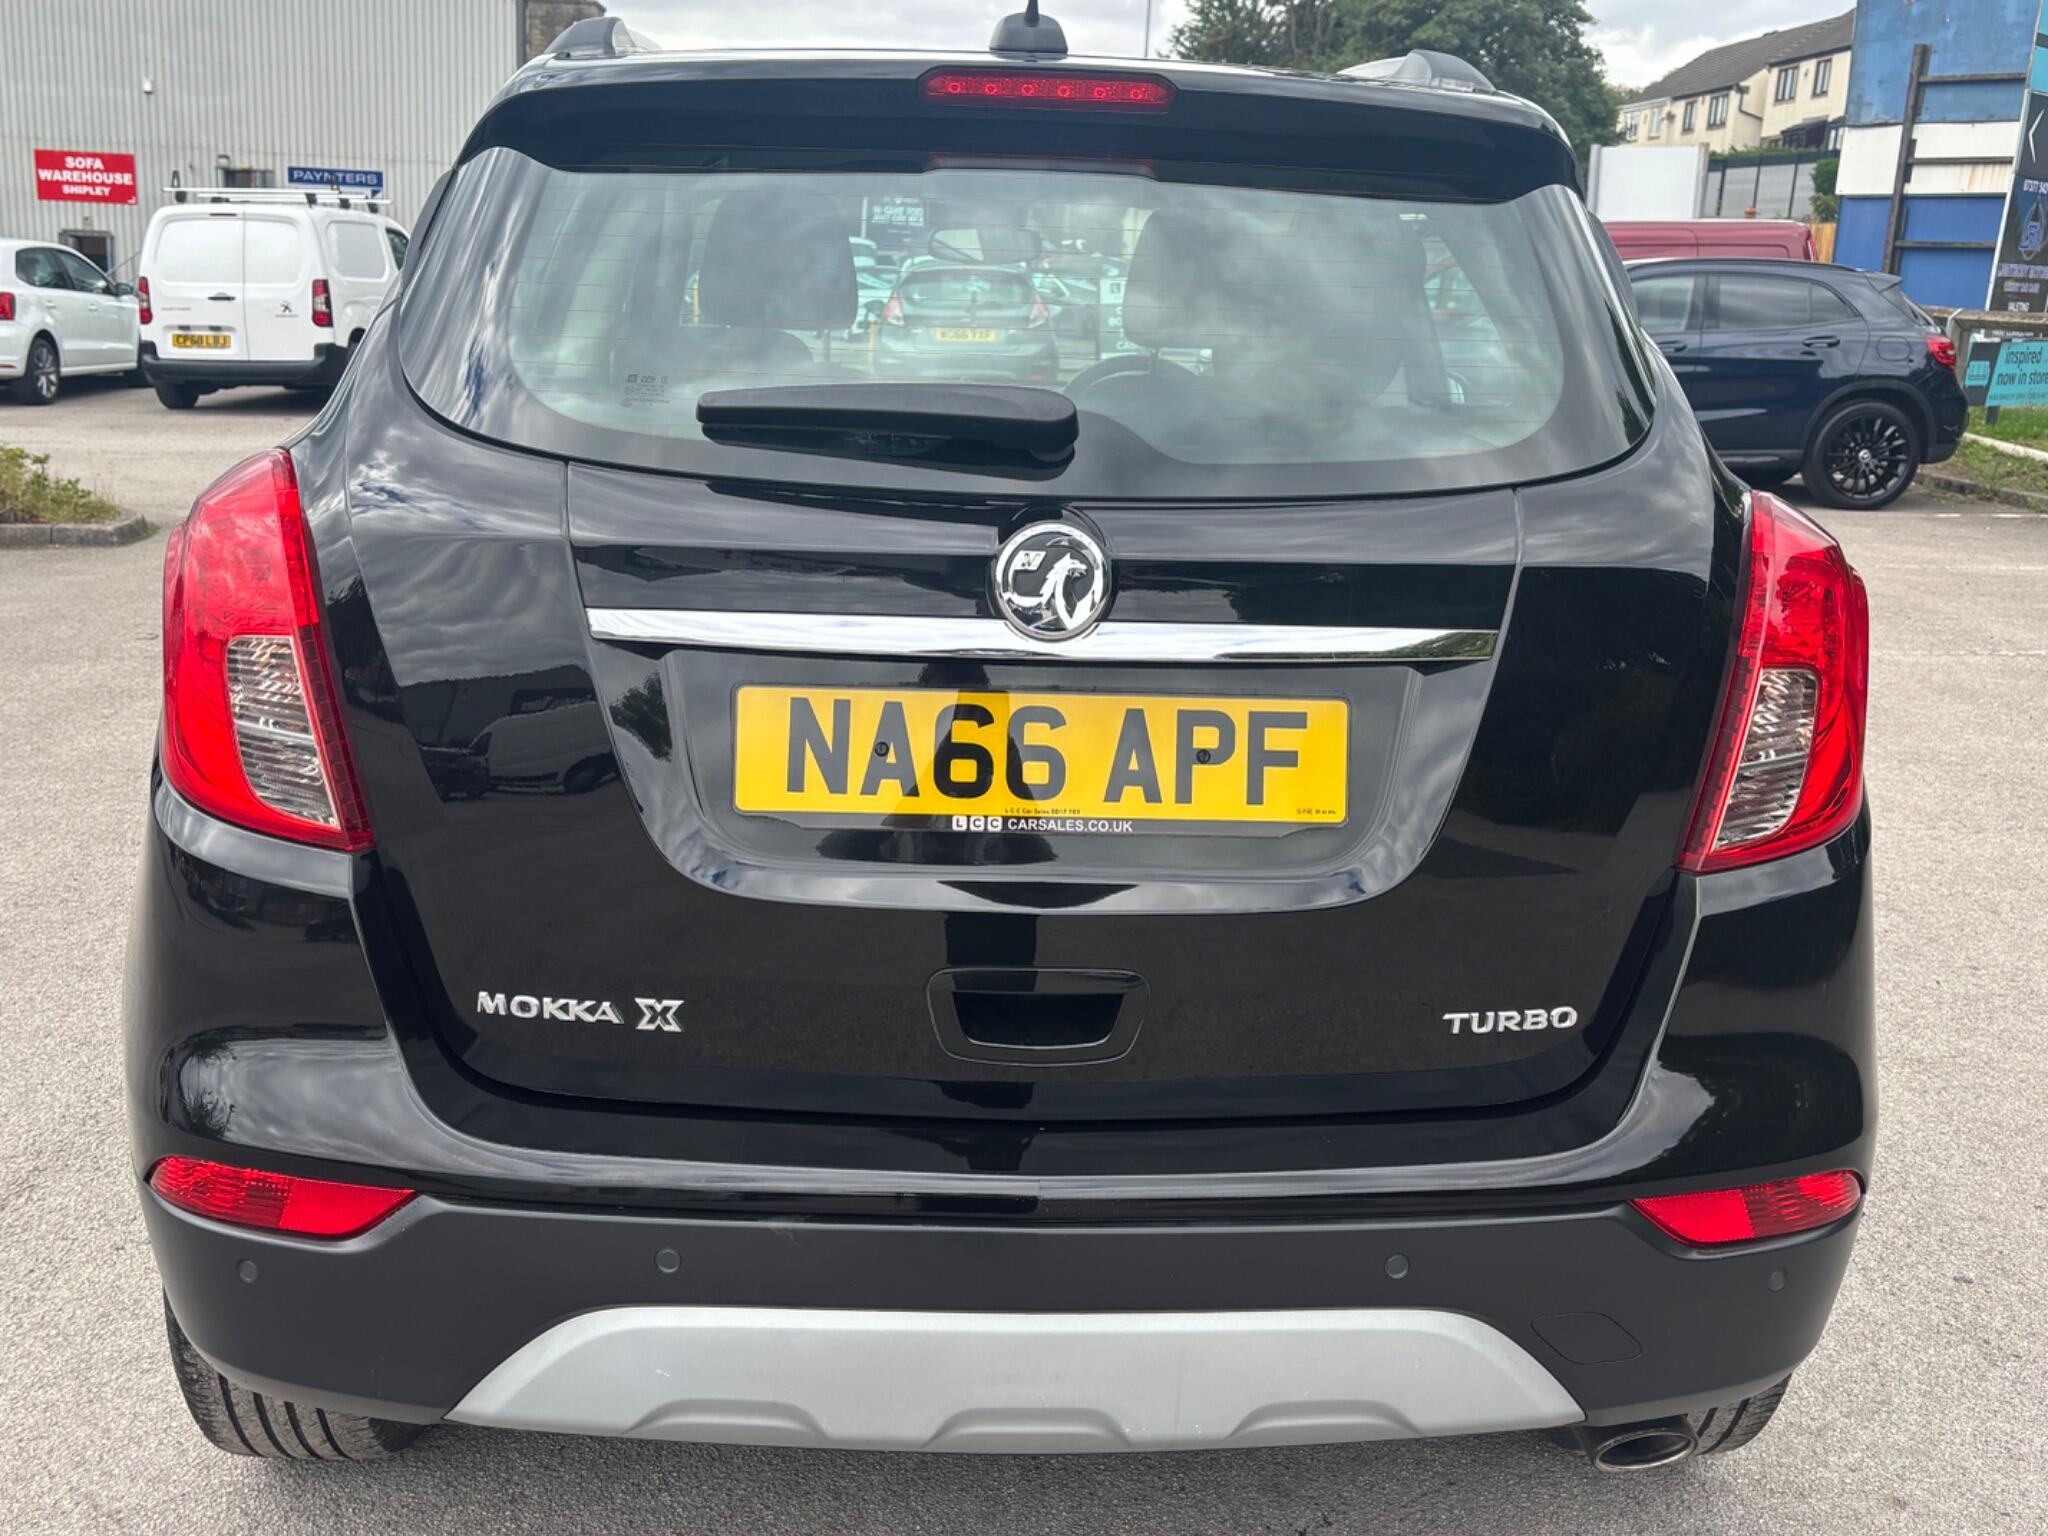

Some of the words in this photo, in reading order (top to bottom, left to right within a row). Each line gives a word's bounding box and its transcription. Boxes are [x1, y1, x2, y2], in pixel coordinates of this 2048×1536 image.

[64, 156, 104, 170] SOFA
[38, 169, 133, 185] WAREHOUSE
[62, 184, 111, 196] SHIPLEY
[2006, 346, 2043, 367] inspired
[1997, 373, 2016, 385] now
[2017, 369, 2028, 385] in
[787, 696, 1066, 800] NA66
[1103, 708, 1308, 805] APF
[1007, 818, 1133, 833] CARSALES.CO.UK
[477, 991, 625, 1024] MOKKA
[634, 997, 685, 1032] X
[1442, 1006, 1578, 1035] TURBO
